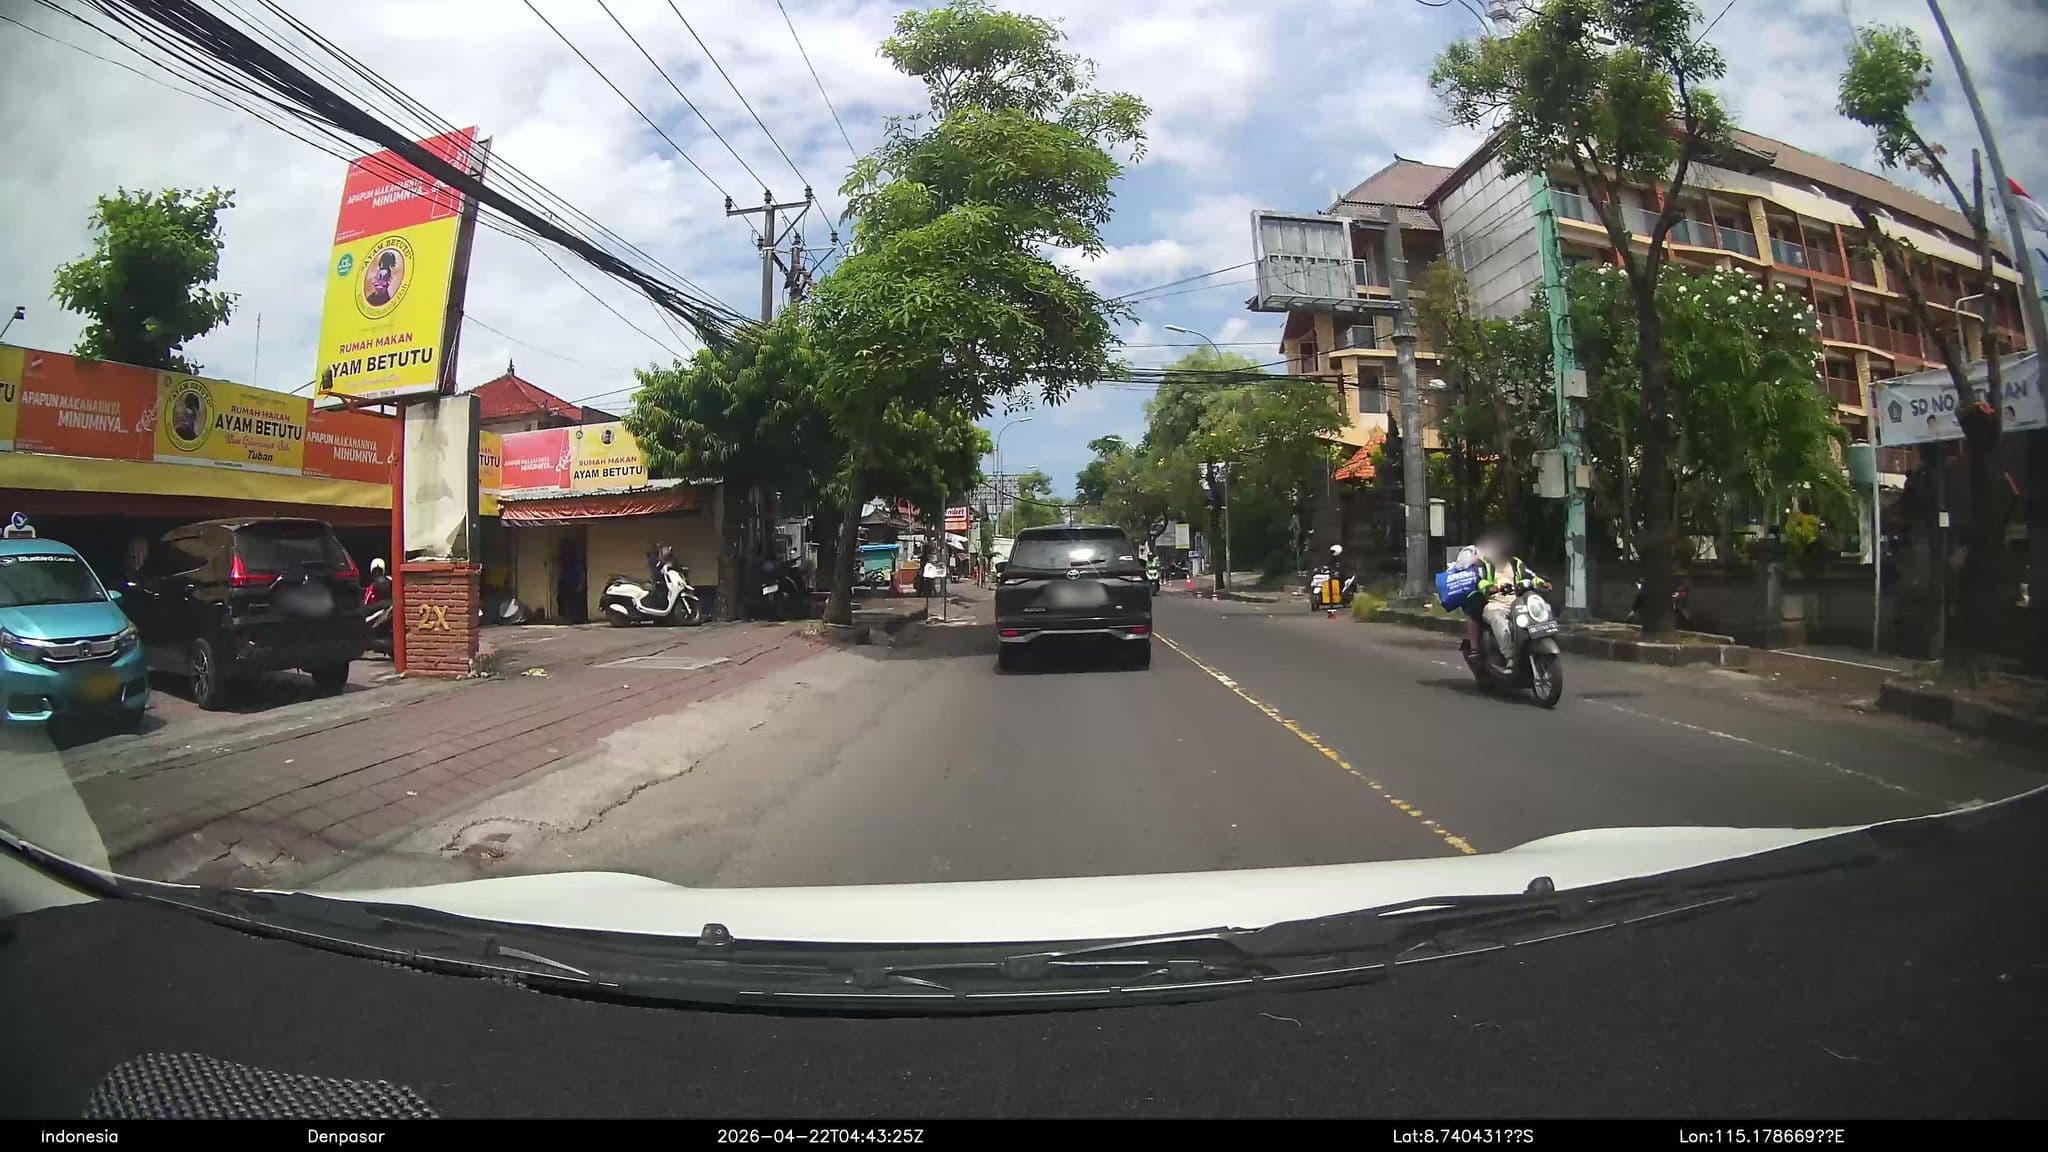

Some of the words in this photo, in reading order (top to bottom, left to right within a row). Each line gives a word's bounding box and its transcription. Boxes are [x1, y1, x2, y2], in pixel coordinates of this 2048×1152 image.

[339, 342, 373, 354] RUMAH
[375, 332, 413, 346] MAKAN
[331, 358, 361, 378] YAM
[366, 347, 433, 372] BETUTU
[21, 390, 59, 407] APAPUN
[231, 405, 261, 417] RUMAH
[263, 410, 290, 422] MAKAN
[1910, 399, 1928, 416] SD
[215, 414, 252, 433] AYAM
[255, 419, 302, 440] BETUTU
[247, 450, 273, 461] Tuban
[578, 458, 606, 467] RUMAH
[607, 455, 637, 465] MAKAN
[573, 469, 600, 481] AYAM
[602, 465, 643, 478] BETUTU
